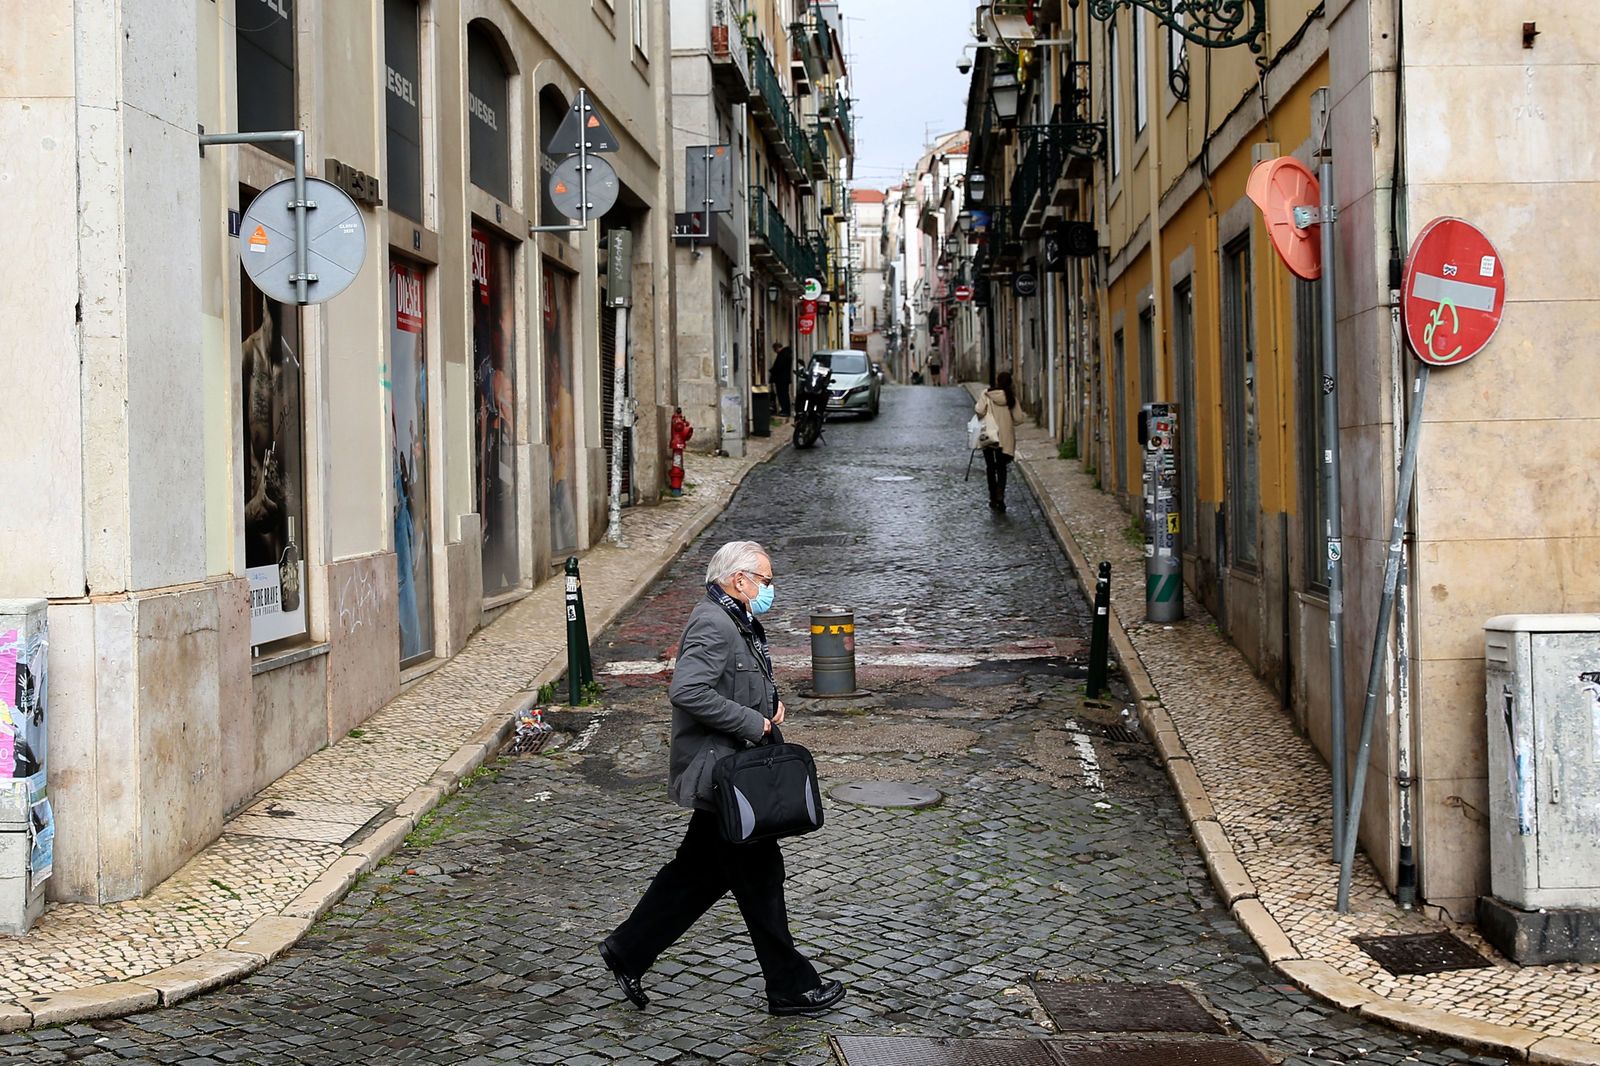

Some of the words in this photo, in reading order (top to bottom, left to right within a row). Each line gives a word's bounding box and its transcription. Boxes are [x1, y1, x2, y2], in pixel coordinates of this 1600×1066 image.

[469, 92, 498, 131] DIESEL
[397, 273, 422, 318] DIESEL
[256, 588, 264, 607] THE
[264, 586, 279, 606] BRAVE
